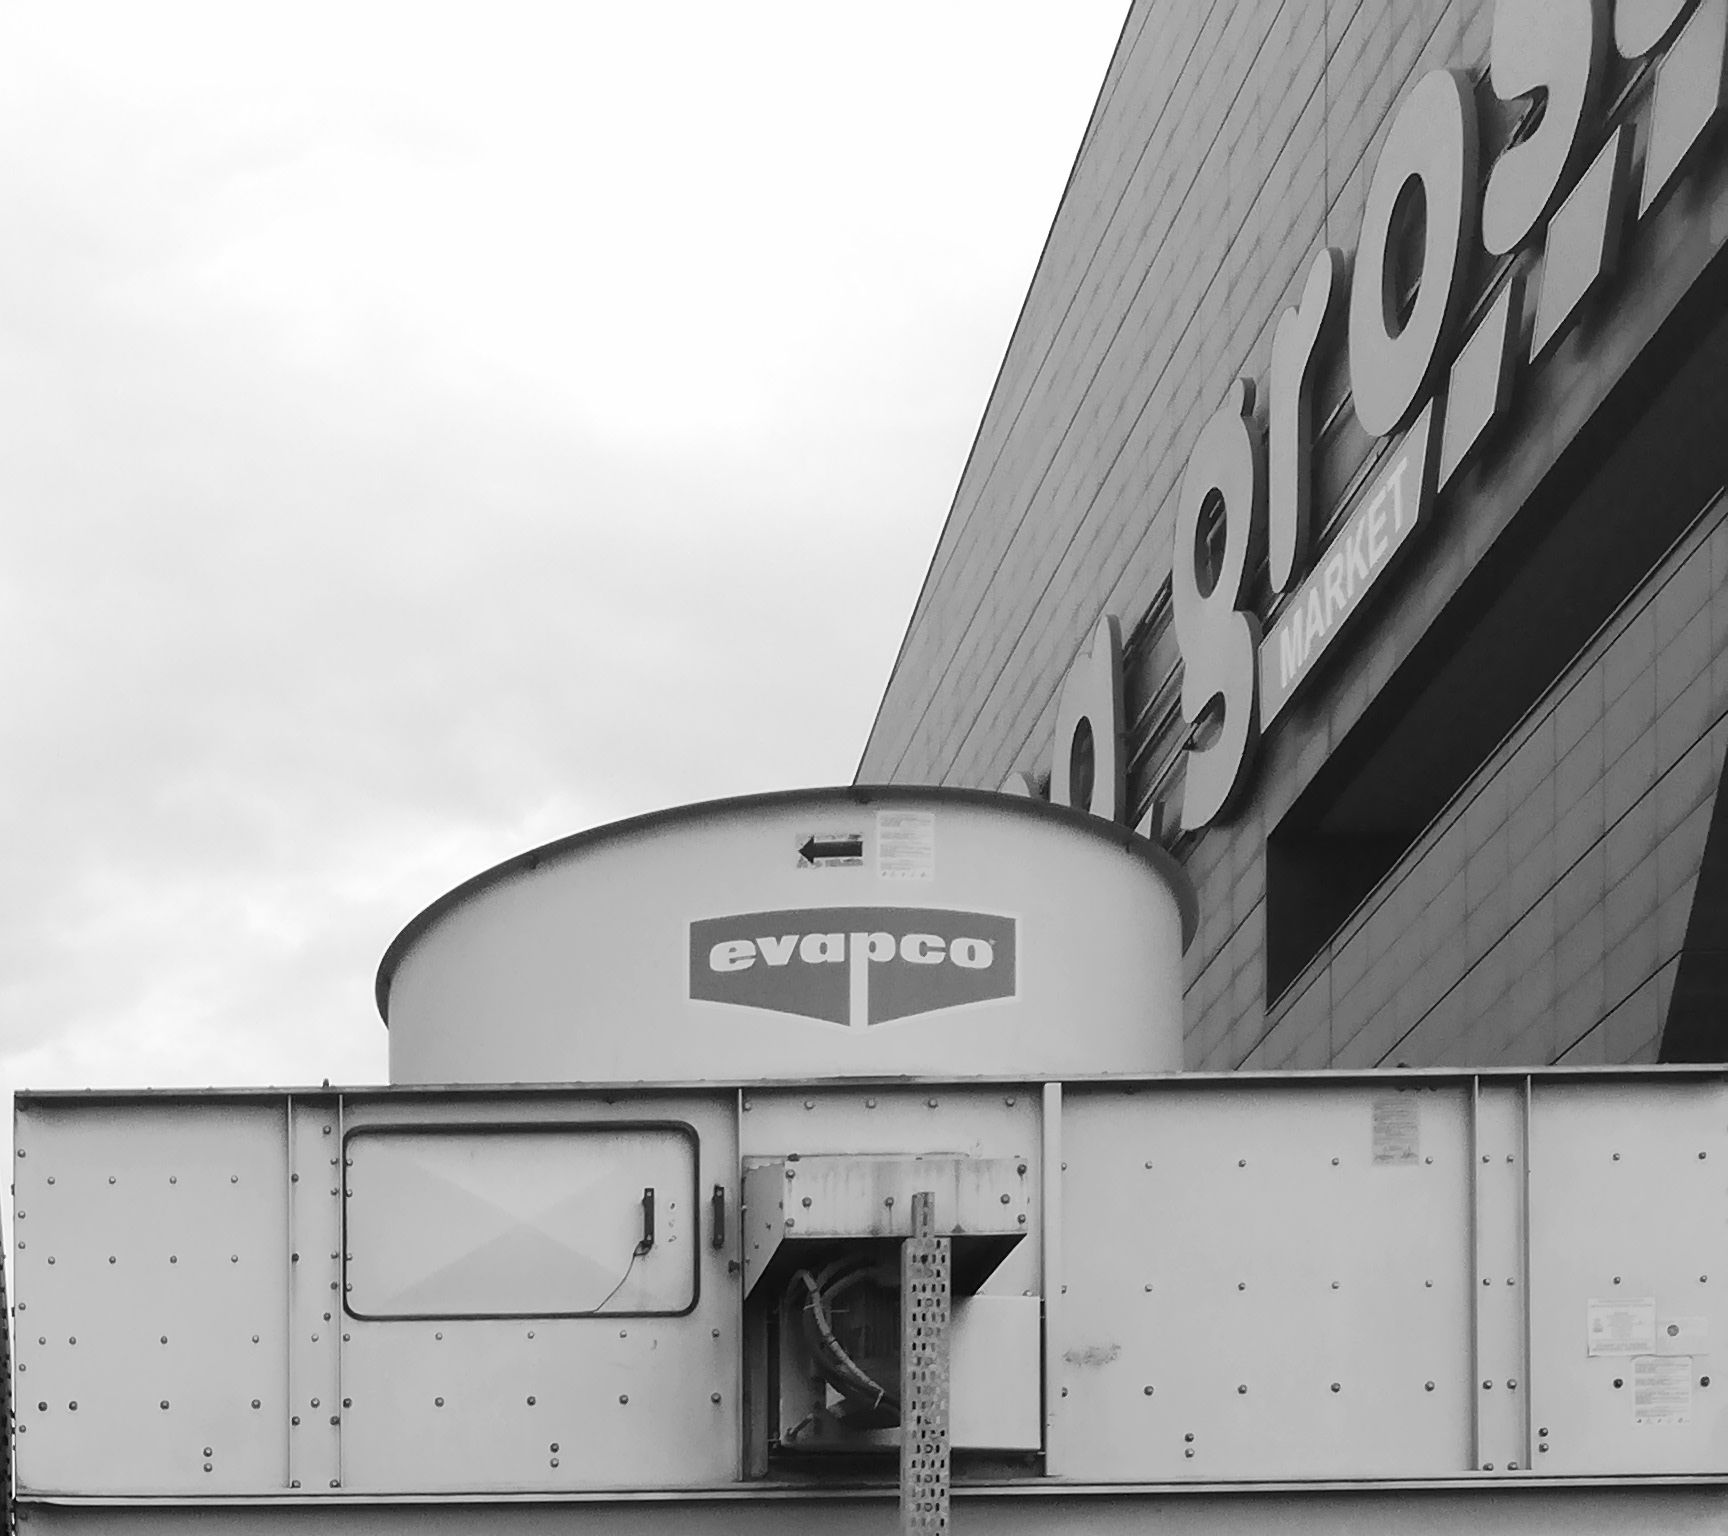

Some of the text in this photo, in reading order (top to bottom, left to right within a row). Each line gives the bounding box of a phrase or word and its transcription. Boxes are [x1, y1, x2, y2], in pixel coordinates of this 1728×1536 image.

[1172, 0, 1686, 832] gros
[1279, 456, 1408, 689] MARKET
[709, 932, 994, 1026] evapco
